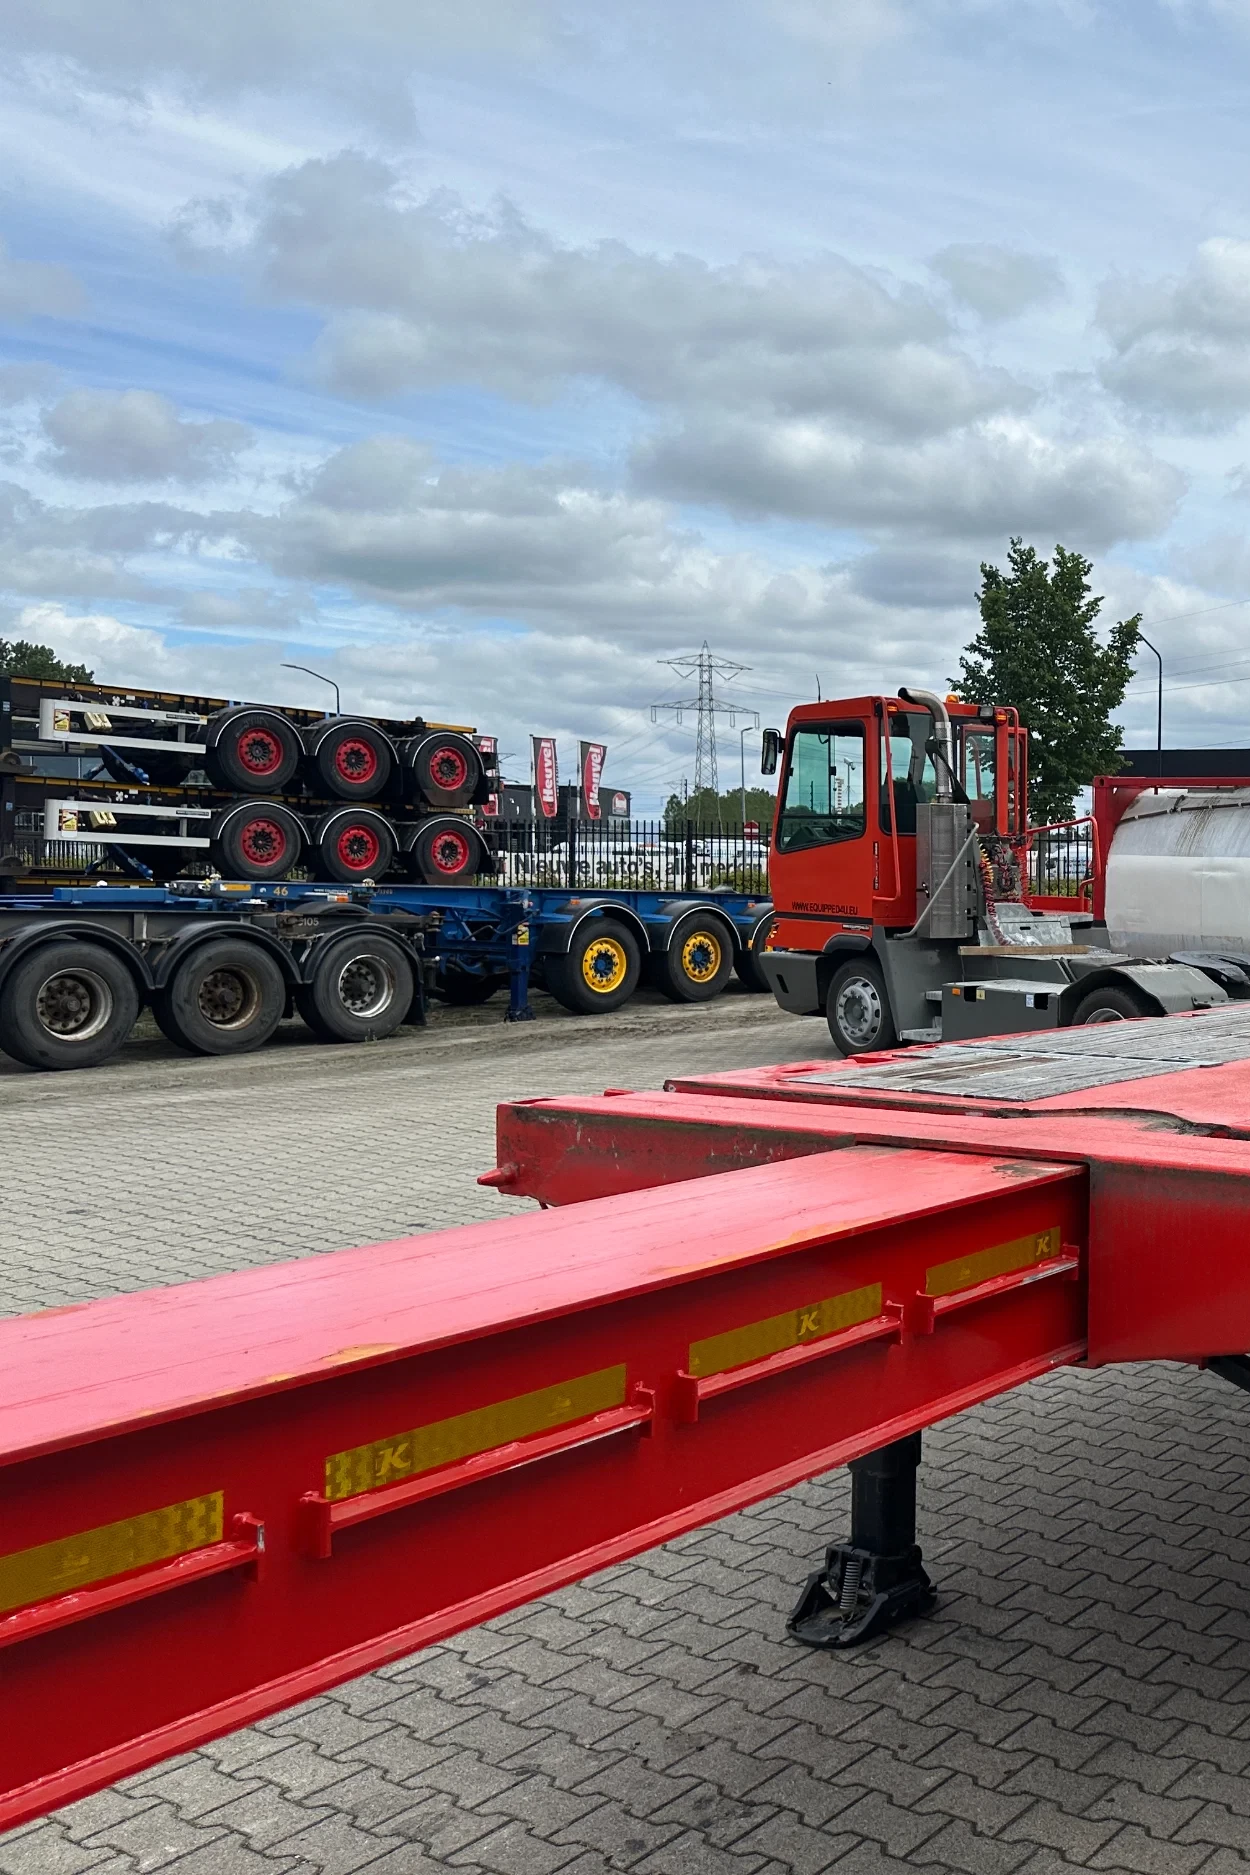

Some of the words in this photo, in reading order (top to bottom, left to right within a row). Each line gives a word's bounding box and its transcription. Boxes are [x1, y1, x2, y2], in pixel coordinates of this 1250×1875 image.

[541, 740, 554, 802] Heuvel
[273, 886, 289, 897] 46
[791, 901, 858, 915] WWW.EQUIPPED4U.EU
